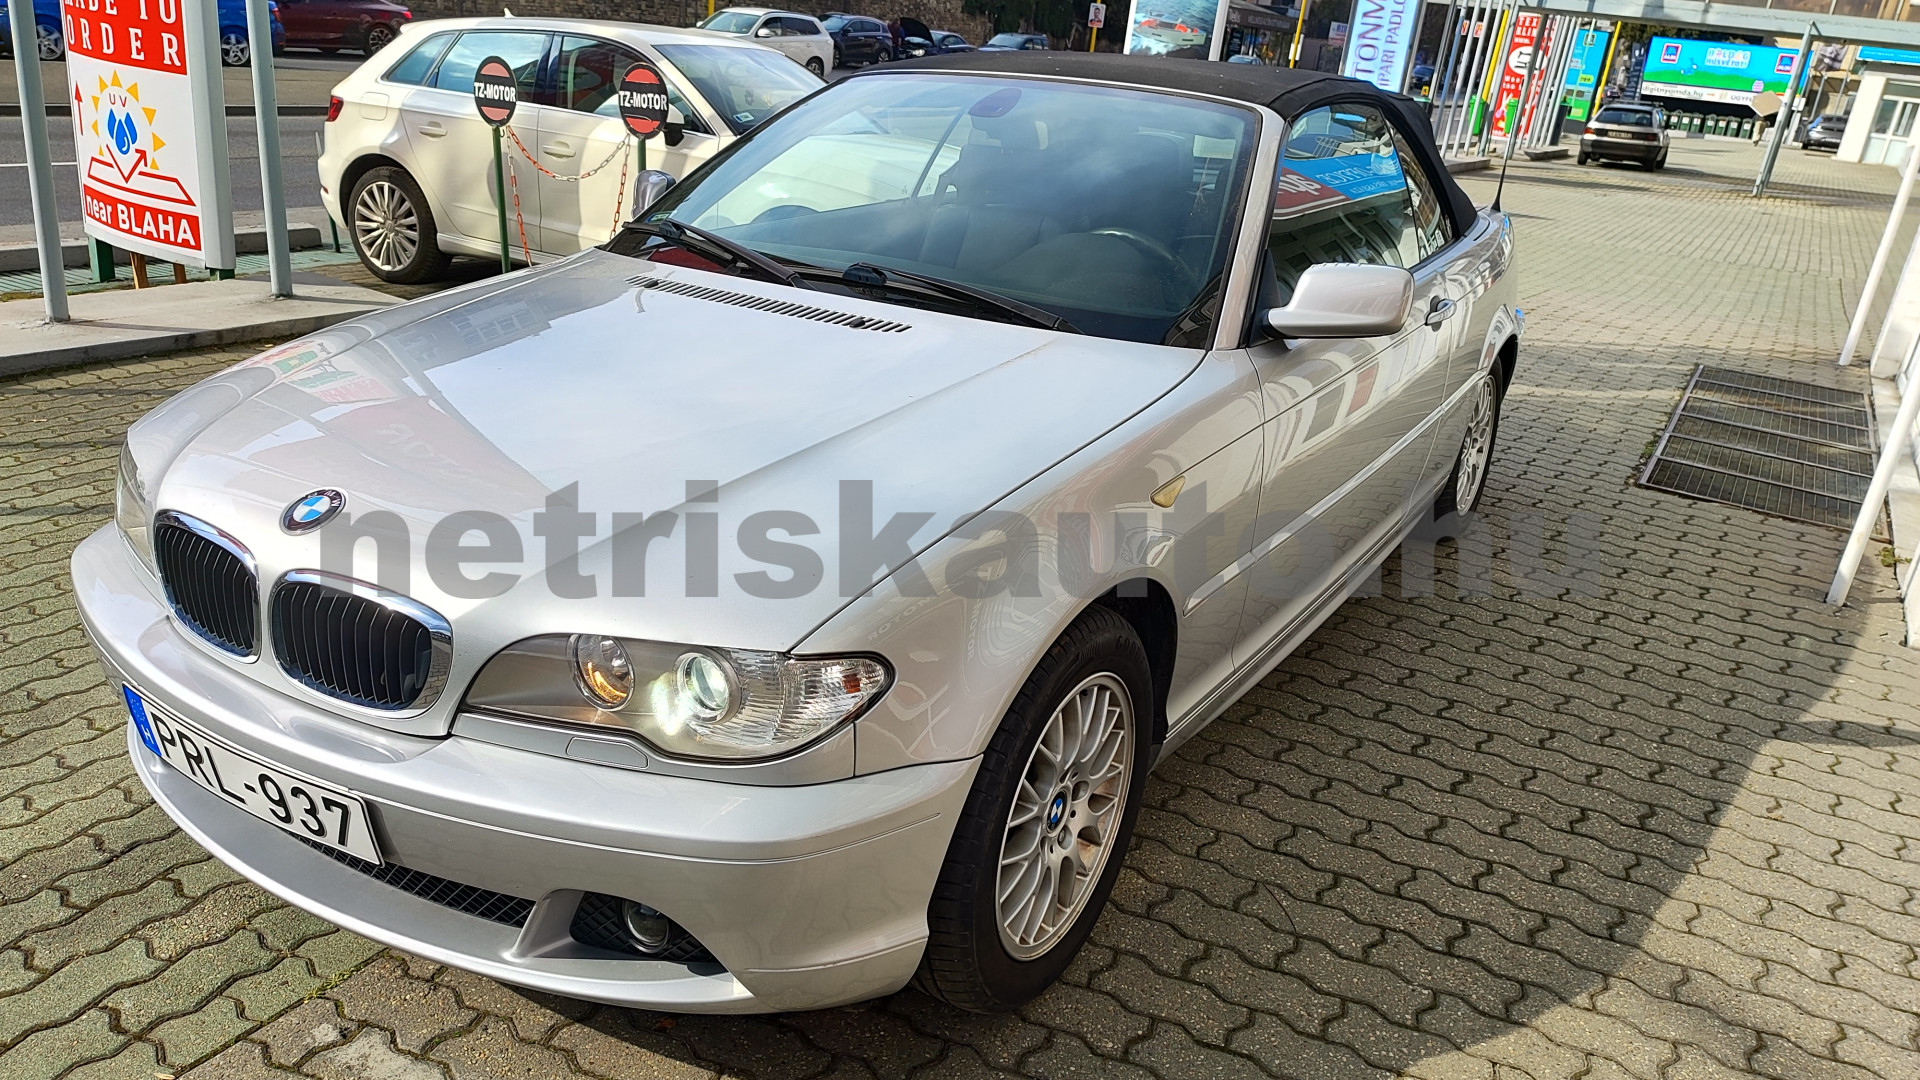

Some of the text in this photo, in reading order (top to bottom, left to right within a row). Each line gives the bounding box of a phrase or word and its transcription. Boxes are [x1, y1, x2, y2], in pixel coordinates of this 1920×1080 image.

[66, 14, 181, 66] ORDER
[108, 93, 127, 107] UV
[473, 82, 516, 102] TZ-MOTOR
[618, 90, 668, 110] TZ-MOTOR
[86, 194, 196, 246] near BLAHA
[150, 711, 350, 847] PRL-937
